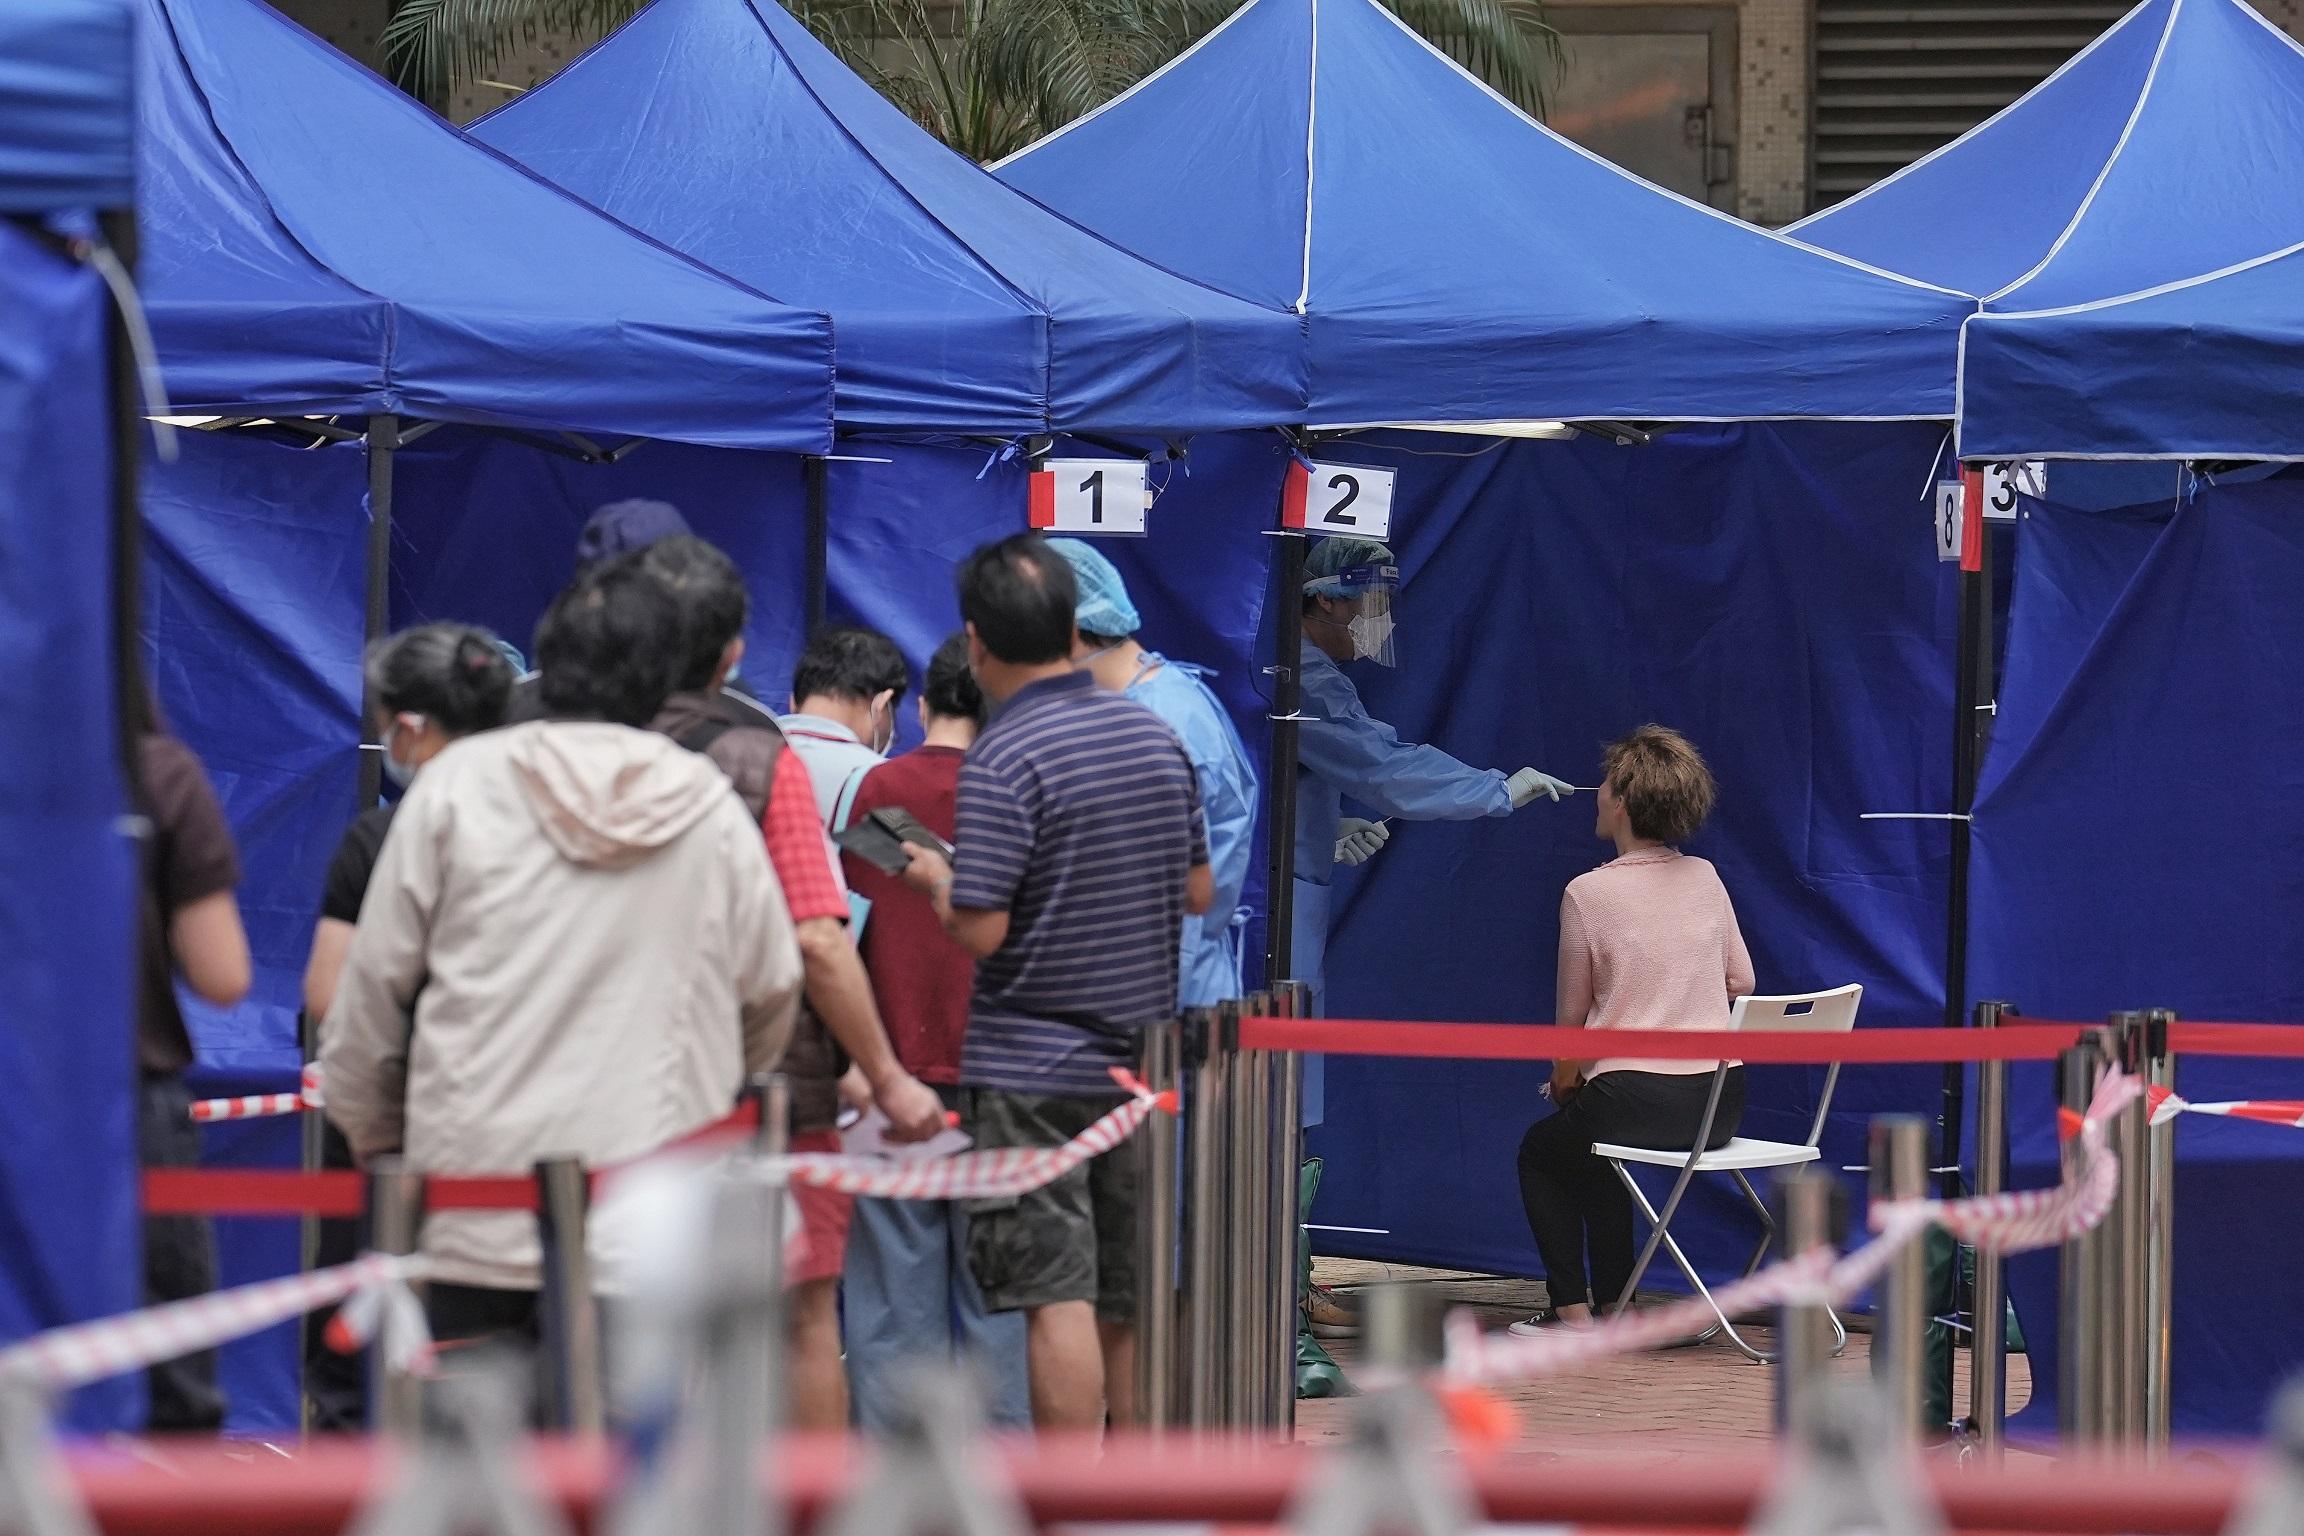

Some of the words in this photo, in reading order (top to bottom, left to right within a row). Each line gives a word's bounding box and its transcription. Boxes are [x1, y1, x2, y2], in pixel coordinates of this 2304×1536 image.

[1079, 470, 1103, 523] 1
[1323, 473, 1360, 526] 2
[1991, 461, 2016, 512] 3
[1944, 493, 1954, 549] 8
